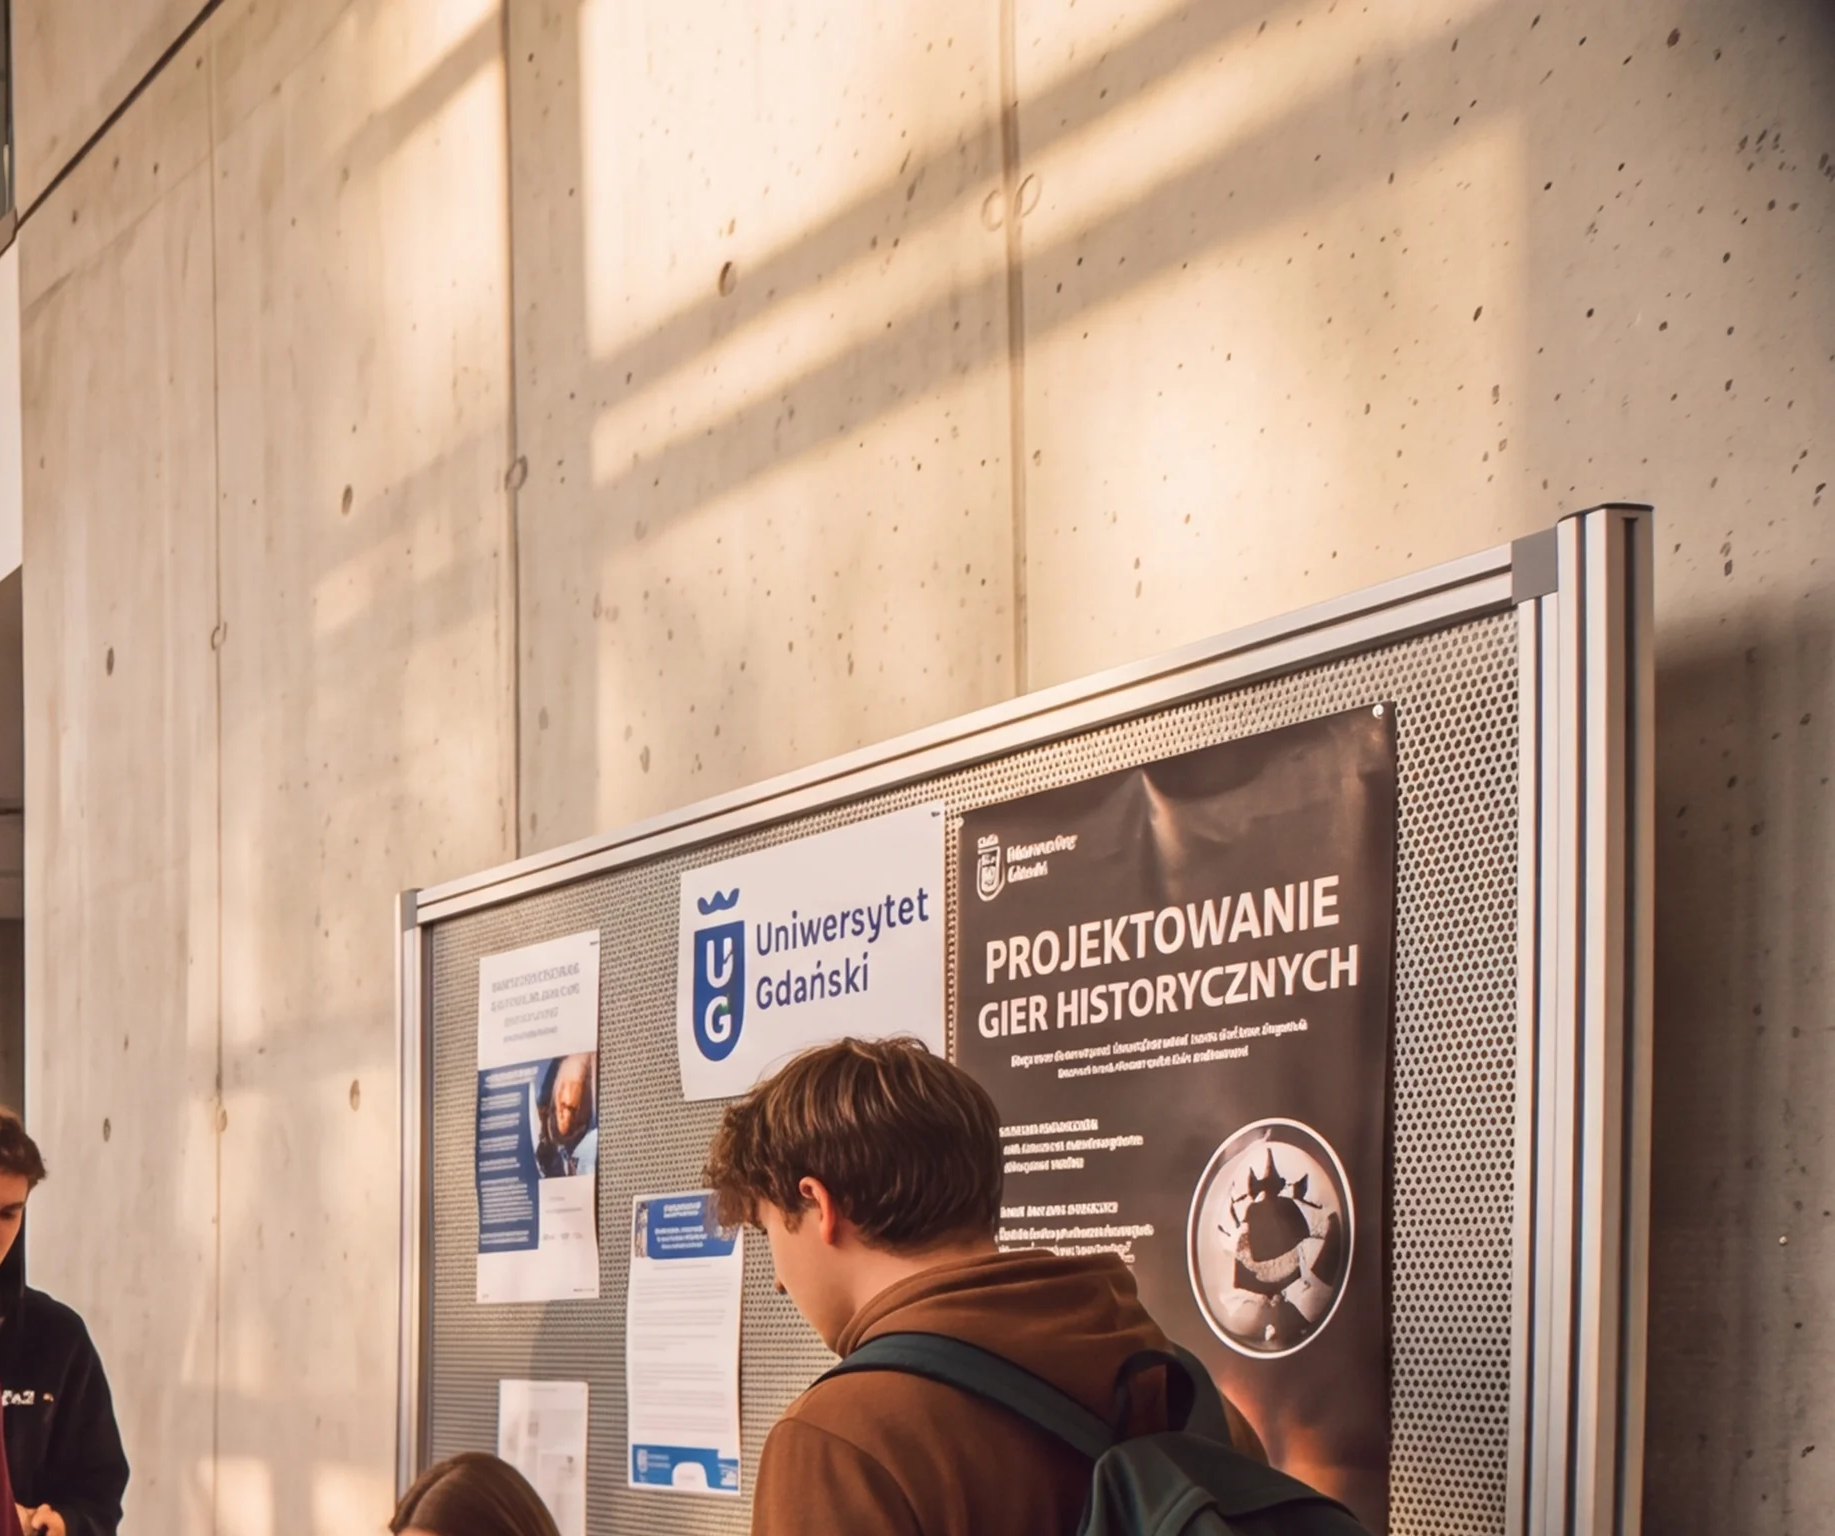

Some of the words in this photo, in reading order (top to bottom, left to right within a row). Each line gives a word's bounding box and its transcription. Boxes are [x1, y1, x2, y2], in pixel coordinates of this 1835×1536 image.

[755, 887, 930, 957] Uniwersytet
[986, 874, 1340, 984] PROJEKTOWANIE
[755, 951, 869, 1010] Gdański
[977, 996, 1048, 1039] GIER
[1056, 944, 1359, 1029] HISTORYCZNYCH
